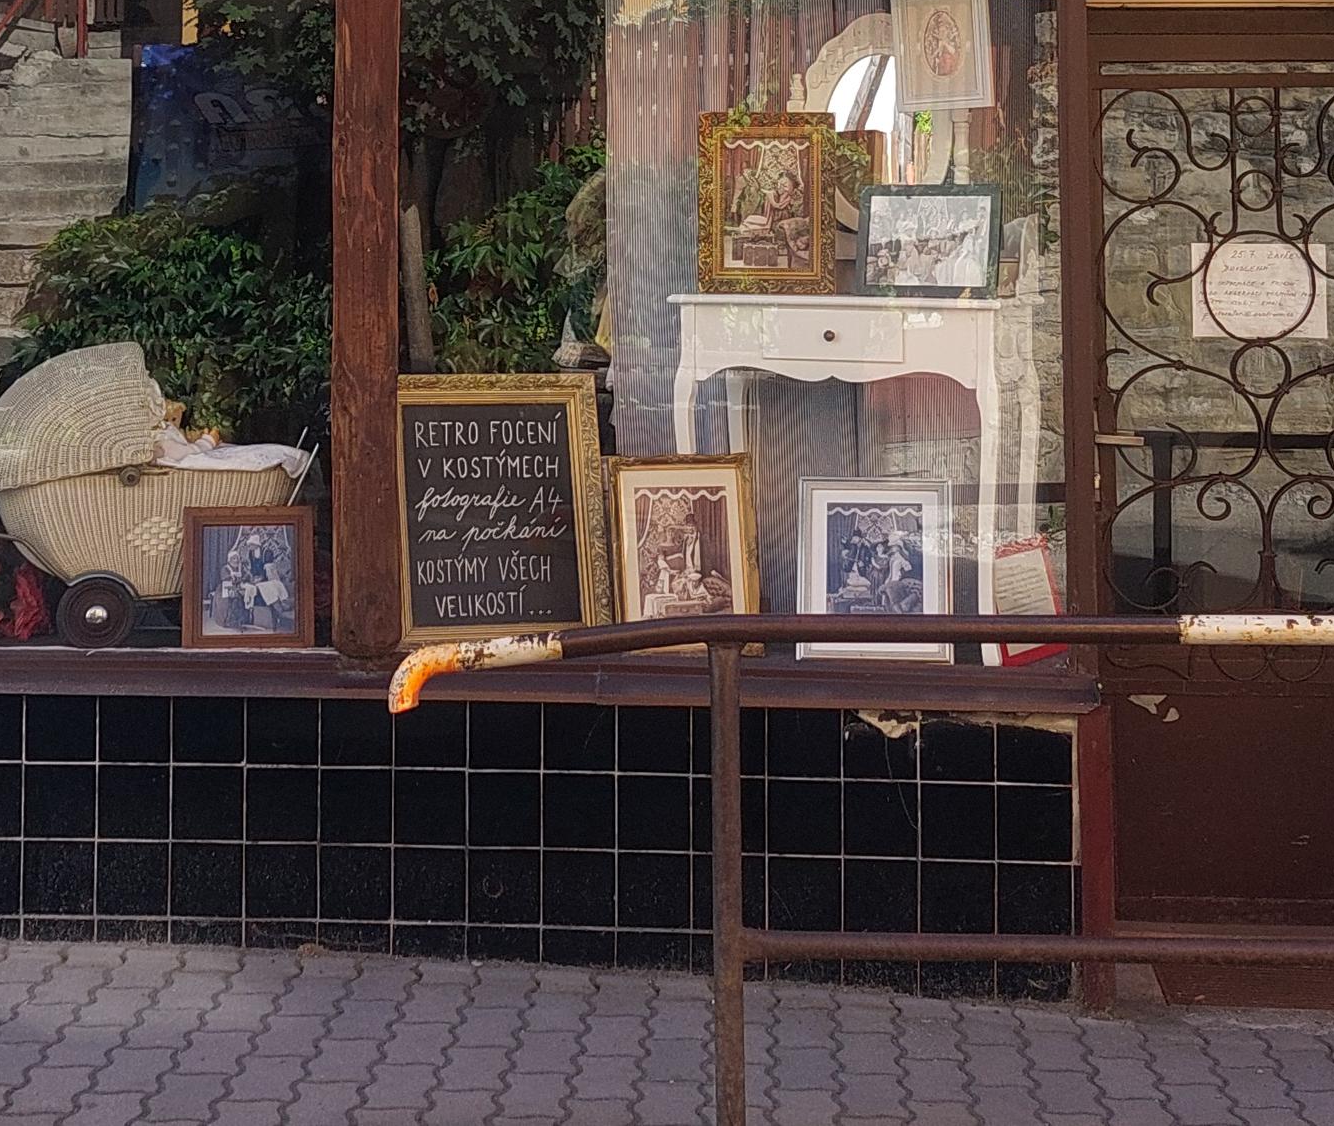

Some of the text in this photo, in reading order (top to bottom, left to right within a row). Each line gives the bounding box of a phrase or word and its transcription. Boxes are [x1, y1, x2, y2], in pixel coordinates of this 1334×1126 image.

[415, 411, 562, 448] RETRO FOCENÍ
[418, 449, 559, 479] V KOSTÝMECH
[415, 484, 563, 521] fotografie A4
[418, 515, 567, 551] na počkání
[417, 550, 551, 585] KOSTÝMY VŠECH
